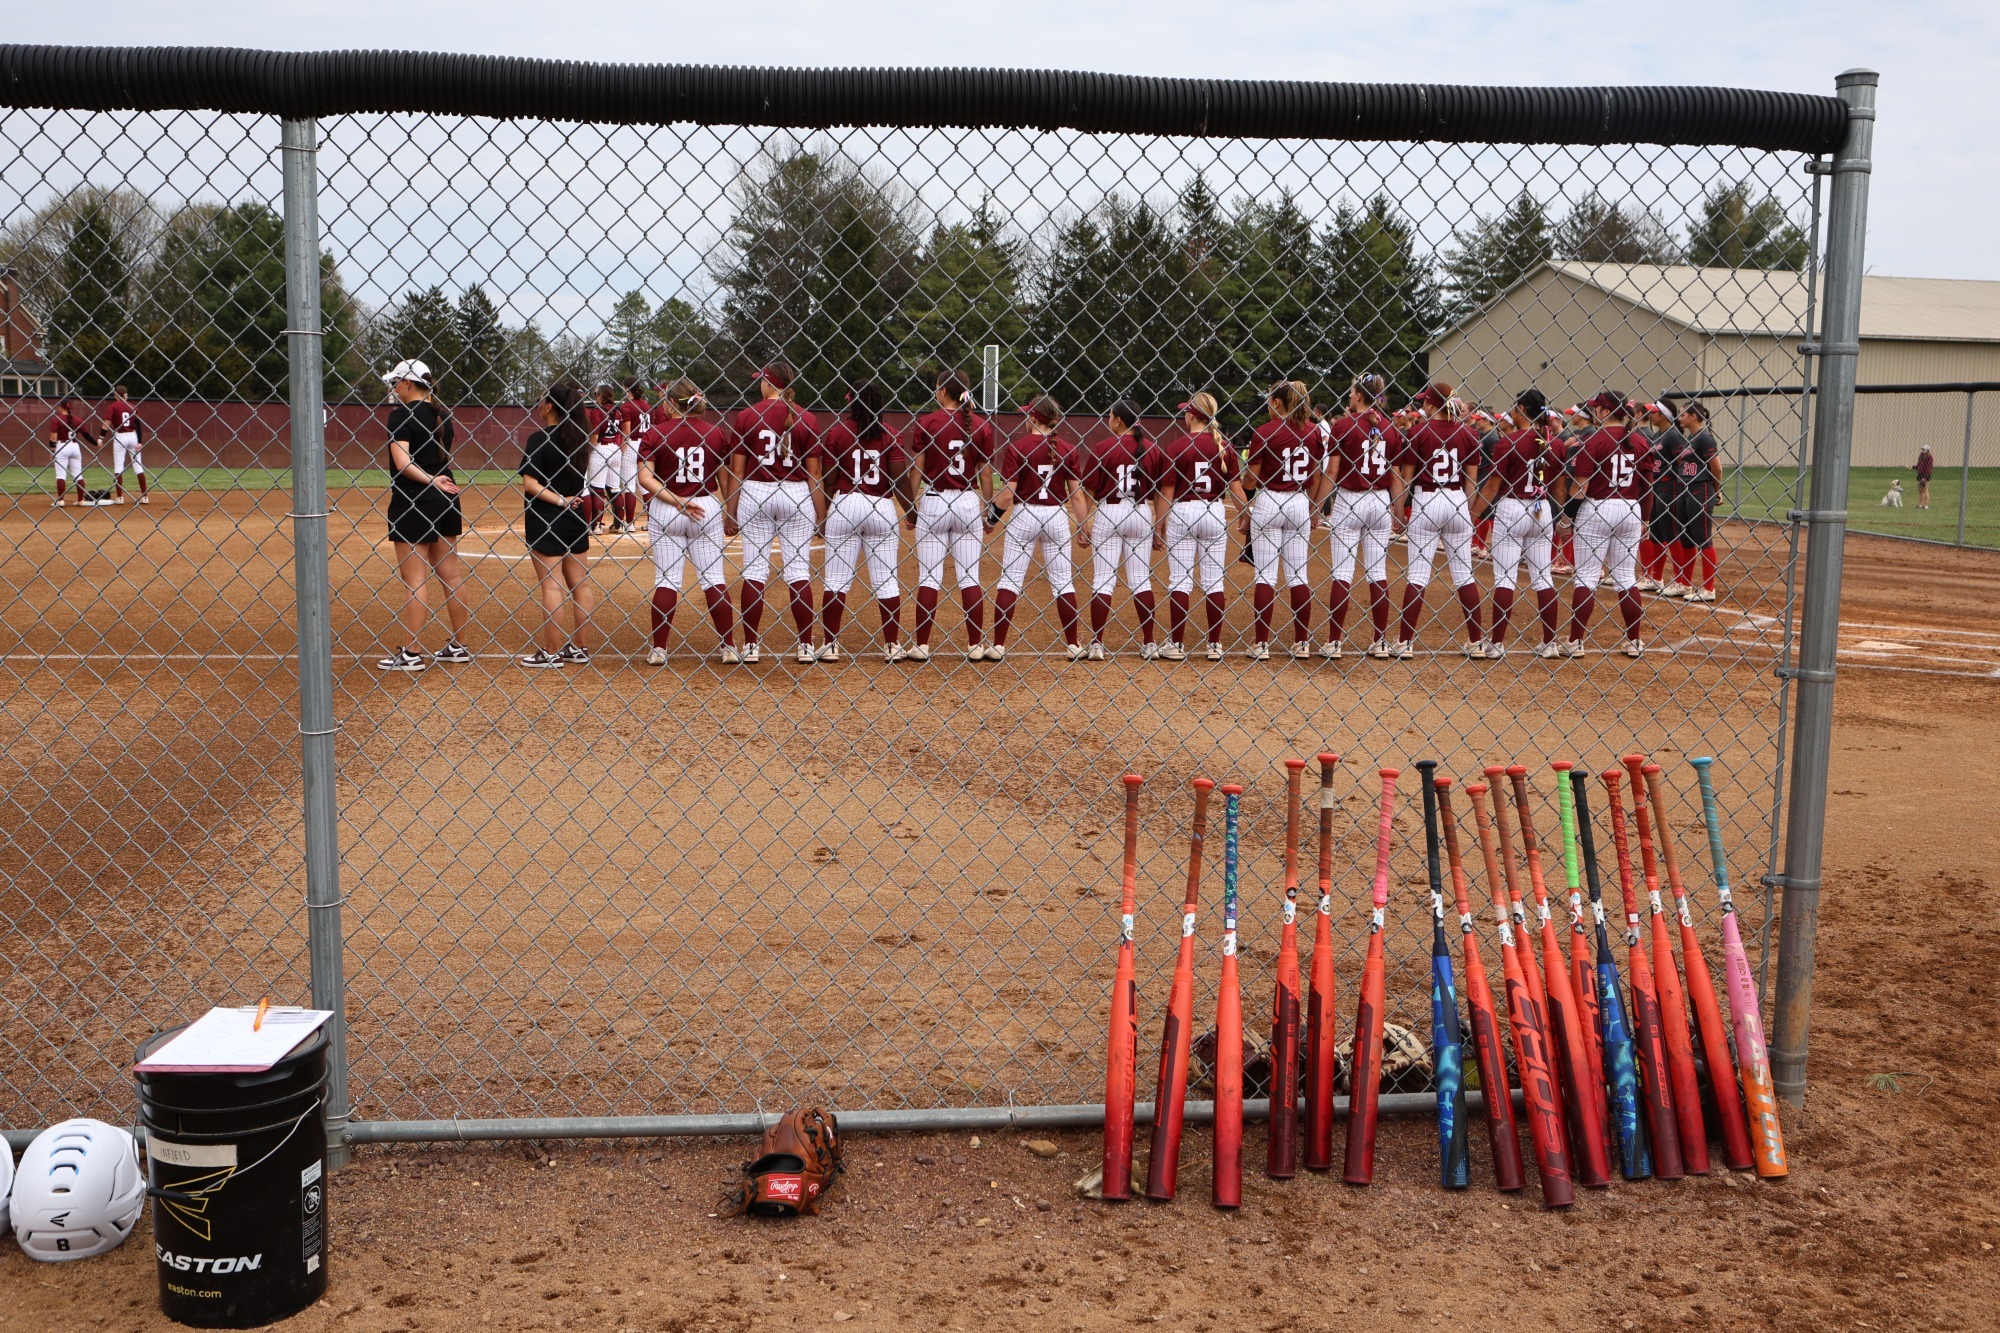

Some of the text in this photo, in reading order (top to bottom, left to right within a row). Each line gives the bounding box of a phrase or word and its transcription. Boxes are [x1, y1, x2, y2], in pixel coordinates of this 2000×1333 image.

[675, 446, 705, 484] 18
[758, 429, 793, 467] 34
[948, 439, 965, 476] 3
[1282, 446, 1309, 482] 12
[1360, 440, 1387, 475] 14
[1432, 448, 1460, 483] 21
[851, 449, 880, 485] 13
[1037, 464, 1054, 500] 7
[1194, 461, 1212, 493] 5
[1608, 454, 1635, 488] 15
[1682, 462, 1697, 476] 20
[1284, 1061, 1294, 1107] EASTON
[1486, 1073, 1500, 1118] EASTON
[1657, 1061, 1670, 1107] EASTON
[1743, 1013, 1784, 1166] EASTON
[160, 1147, 191, 1161] INFIELD
[770, 1180, 799, 1195] Rawlings
[56, 1238, 70, 1251] 8
[156, 1242, 262, 1274] EASTON
[167, 1282, 222, 1298] easton.com
